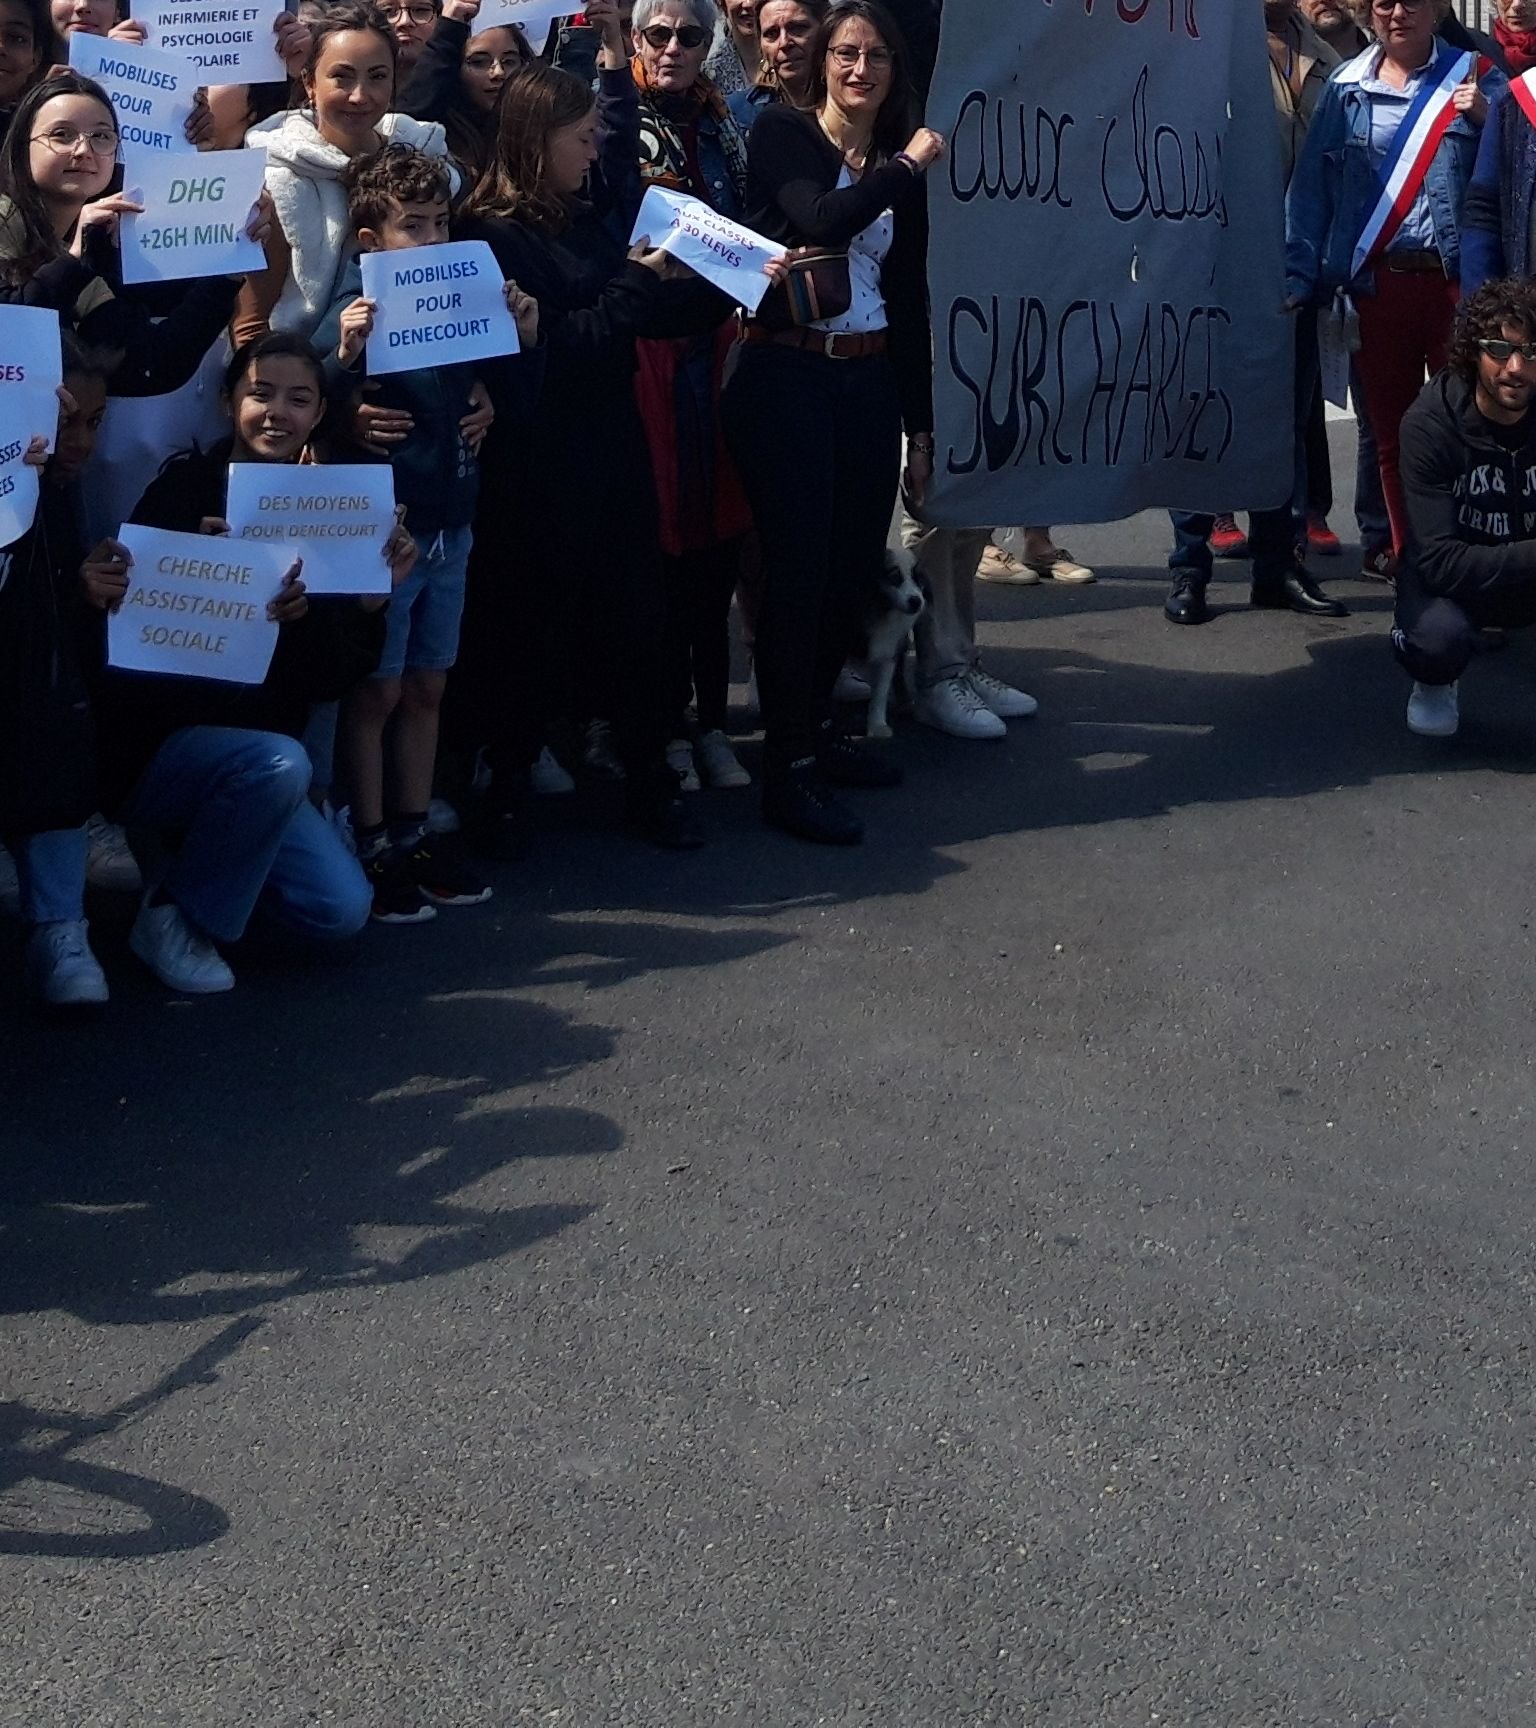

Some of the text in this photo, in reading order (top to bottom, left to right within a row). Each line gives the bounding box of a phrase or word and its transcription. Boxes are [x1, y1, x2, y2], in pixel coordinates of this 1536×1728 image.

[158, 9, 260, 26] INFIRMIERIE ET
[161, 30, 254, 47] PSYCHOLOGIE
[99, 57, 178, 91] MOBILISES
[112, 91, 152, 116] POUR
[120, 124, 172, 149] COURT
[948, 88, 1075, 208] aux
[168, 176, 226, 204] DHG
[139, 223, 241, 250] +26H MIN.
[670, 218, 742, 268] A 30 ELEVES
[672, 207, 756, 252] AUX CLASSES
[394, 259, 480, 287] MOBILISES
[415, 292, 464, 314] POUR
[388, 317, 491, 350] DENECOURT
[258, 495, 370, 512] DES MOYENS
[241, 524, 379, 538] POUR DENECOURT
[158, 555, 253, 586] CHERCHE
[130, 587, 258, 622] ASSISTANTE
[140, 624, 229, 654] SOCIALE
